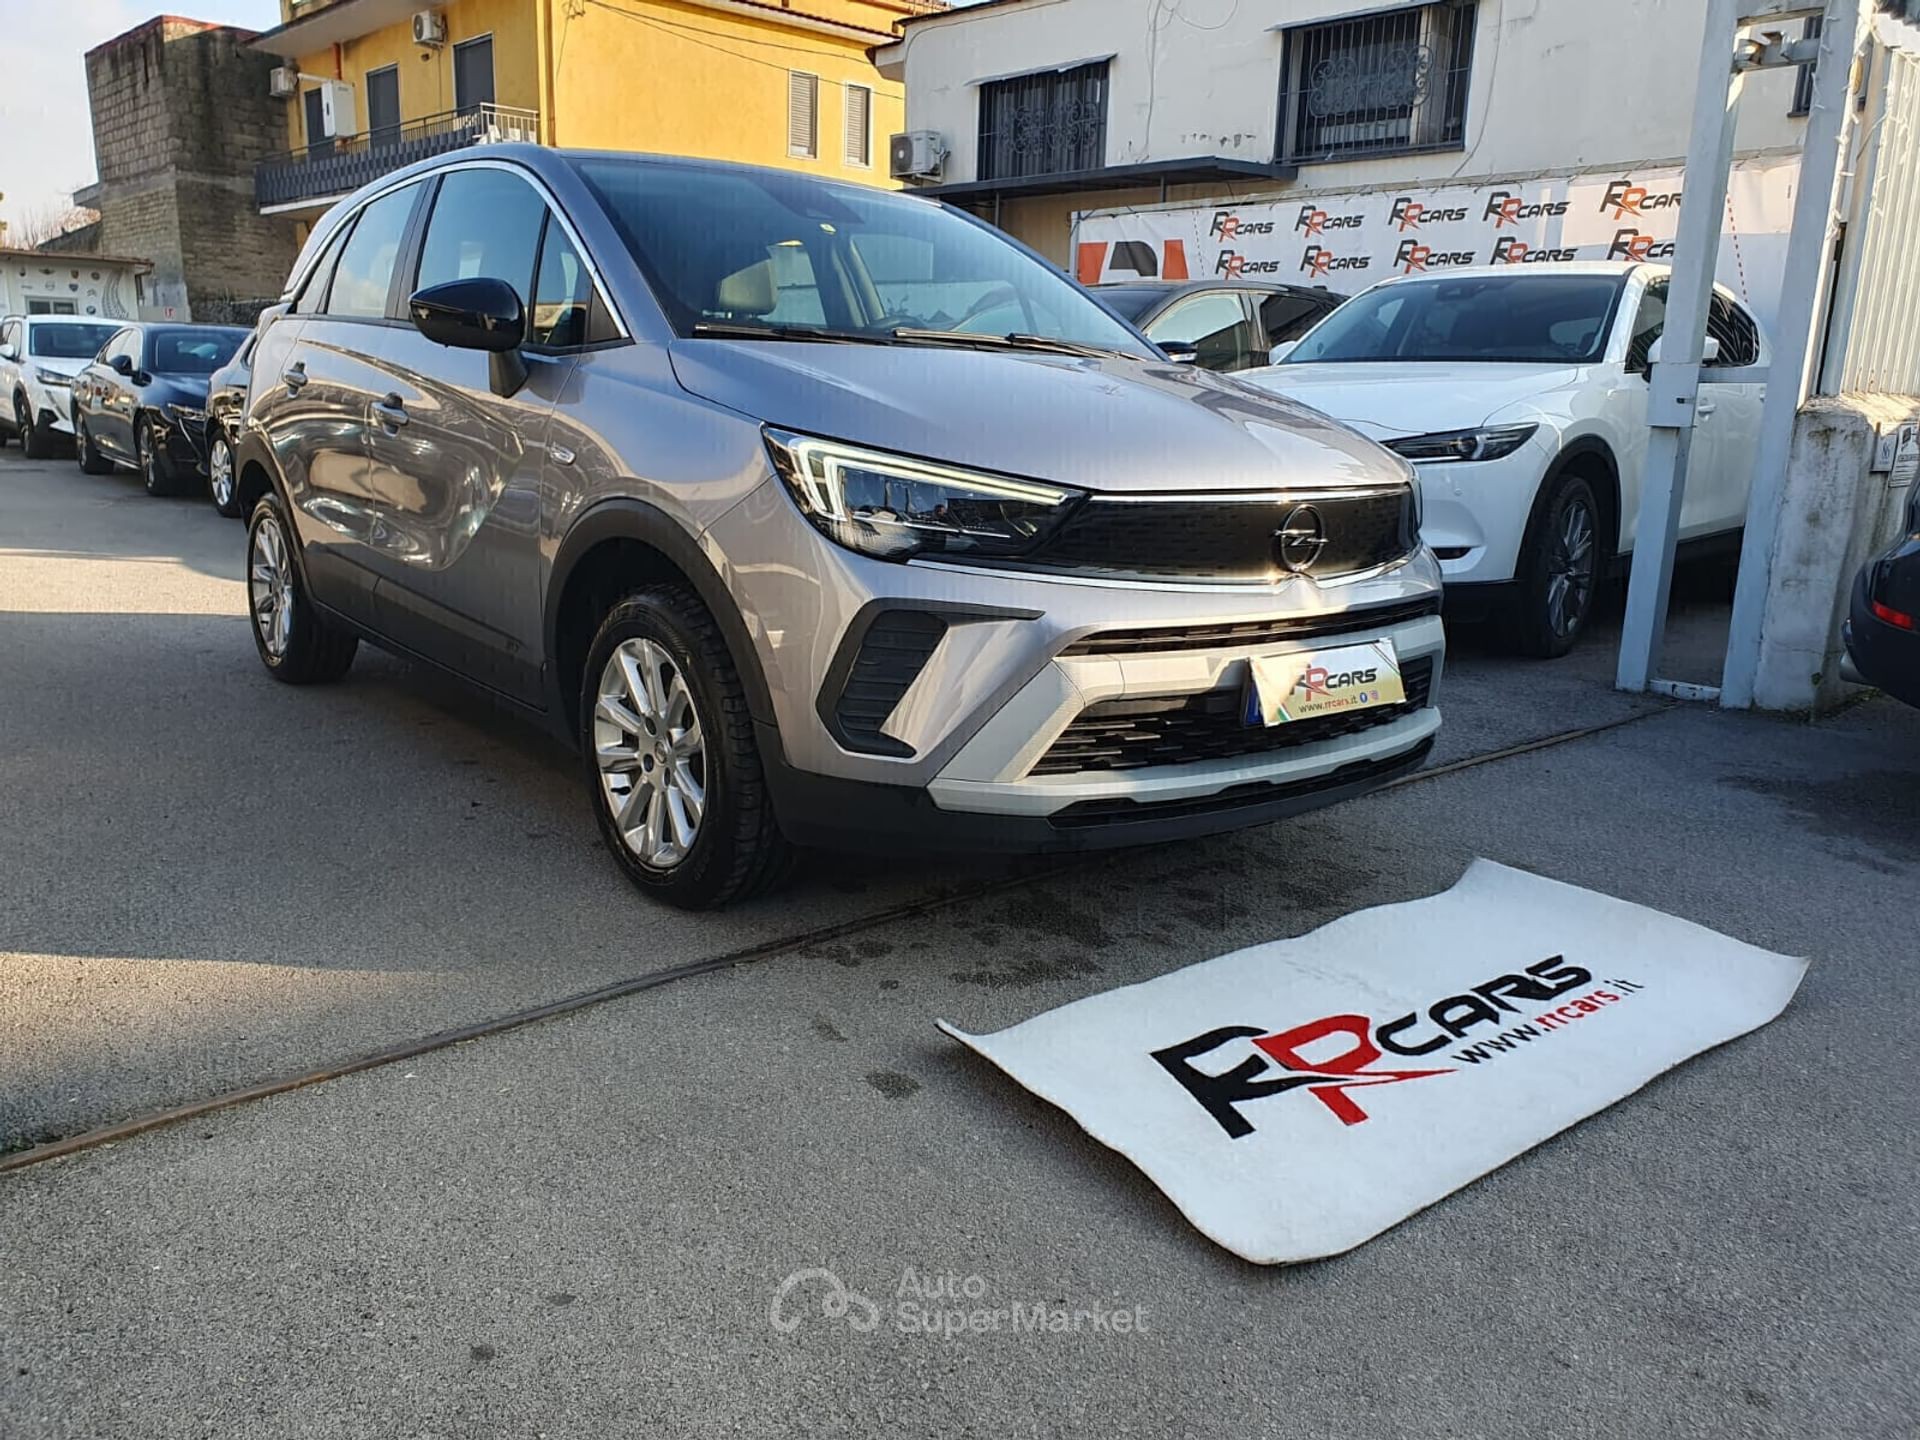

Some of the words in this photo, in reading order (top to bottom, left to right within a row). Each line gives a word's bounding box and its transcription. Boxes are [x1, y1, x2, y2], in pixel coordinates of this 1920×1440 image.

[1600, 181, 1682, 220] RRCAR
[1607, 229, 1675, 262] RRCA
[1299, 695, 1358, 713] www.rrcars.it
[1450, 979, 1645, 1065] www.rrcars.it
